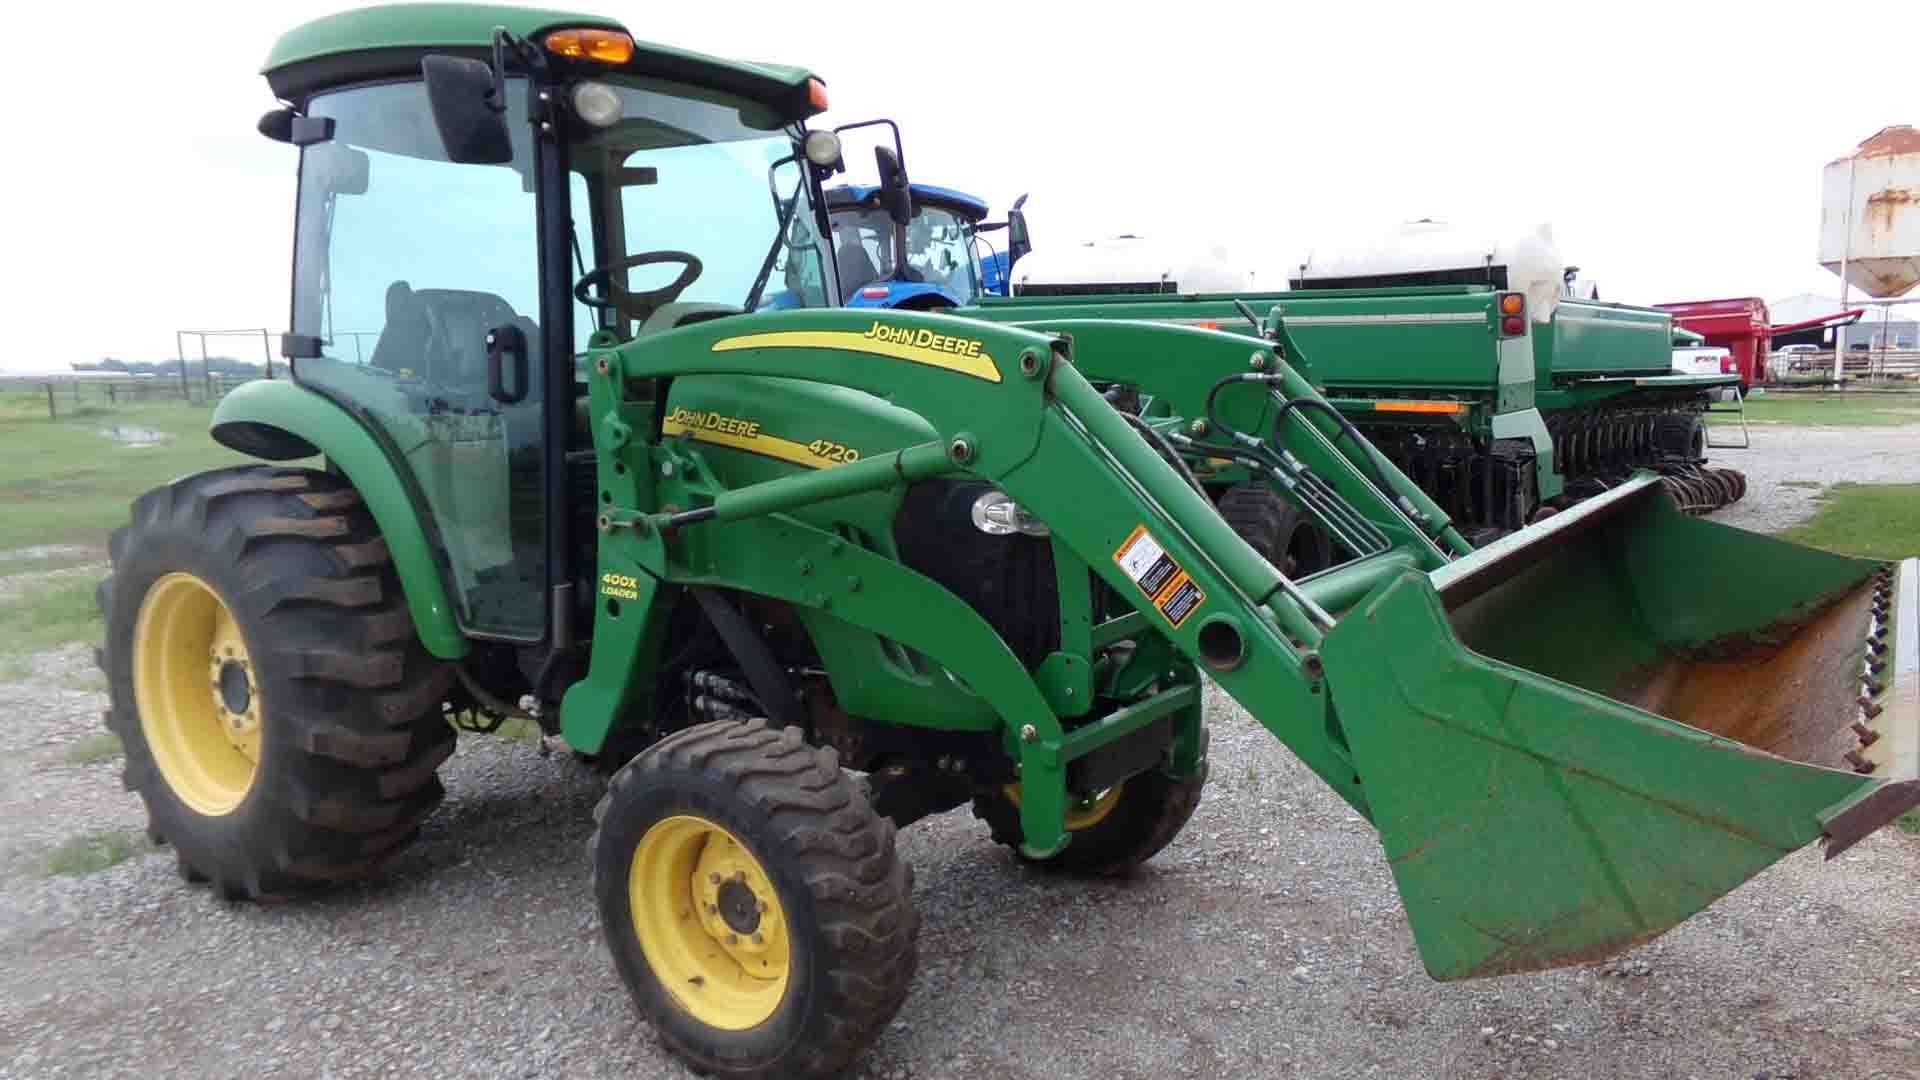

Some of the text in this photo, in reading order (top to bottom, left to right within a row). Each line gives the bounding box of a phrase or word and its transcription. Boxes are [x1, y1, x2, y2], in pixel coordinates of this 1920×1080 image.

[864, 320, 982, 358] JOHN DEERE
[664, 406, 760, 438] JOHN DEERE
[808, 439, 859, 464] 4720
[601, 573, 638, 588] 400X
[601, 586, 639, 600] LOADER
